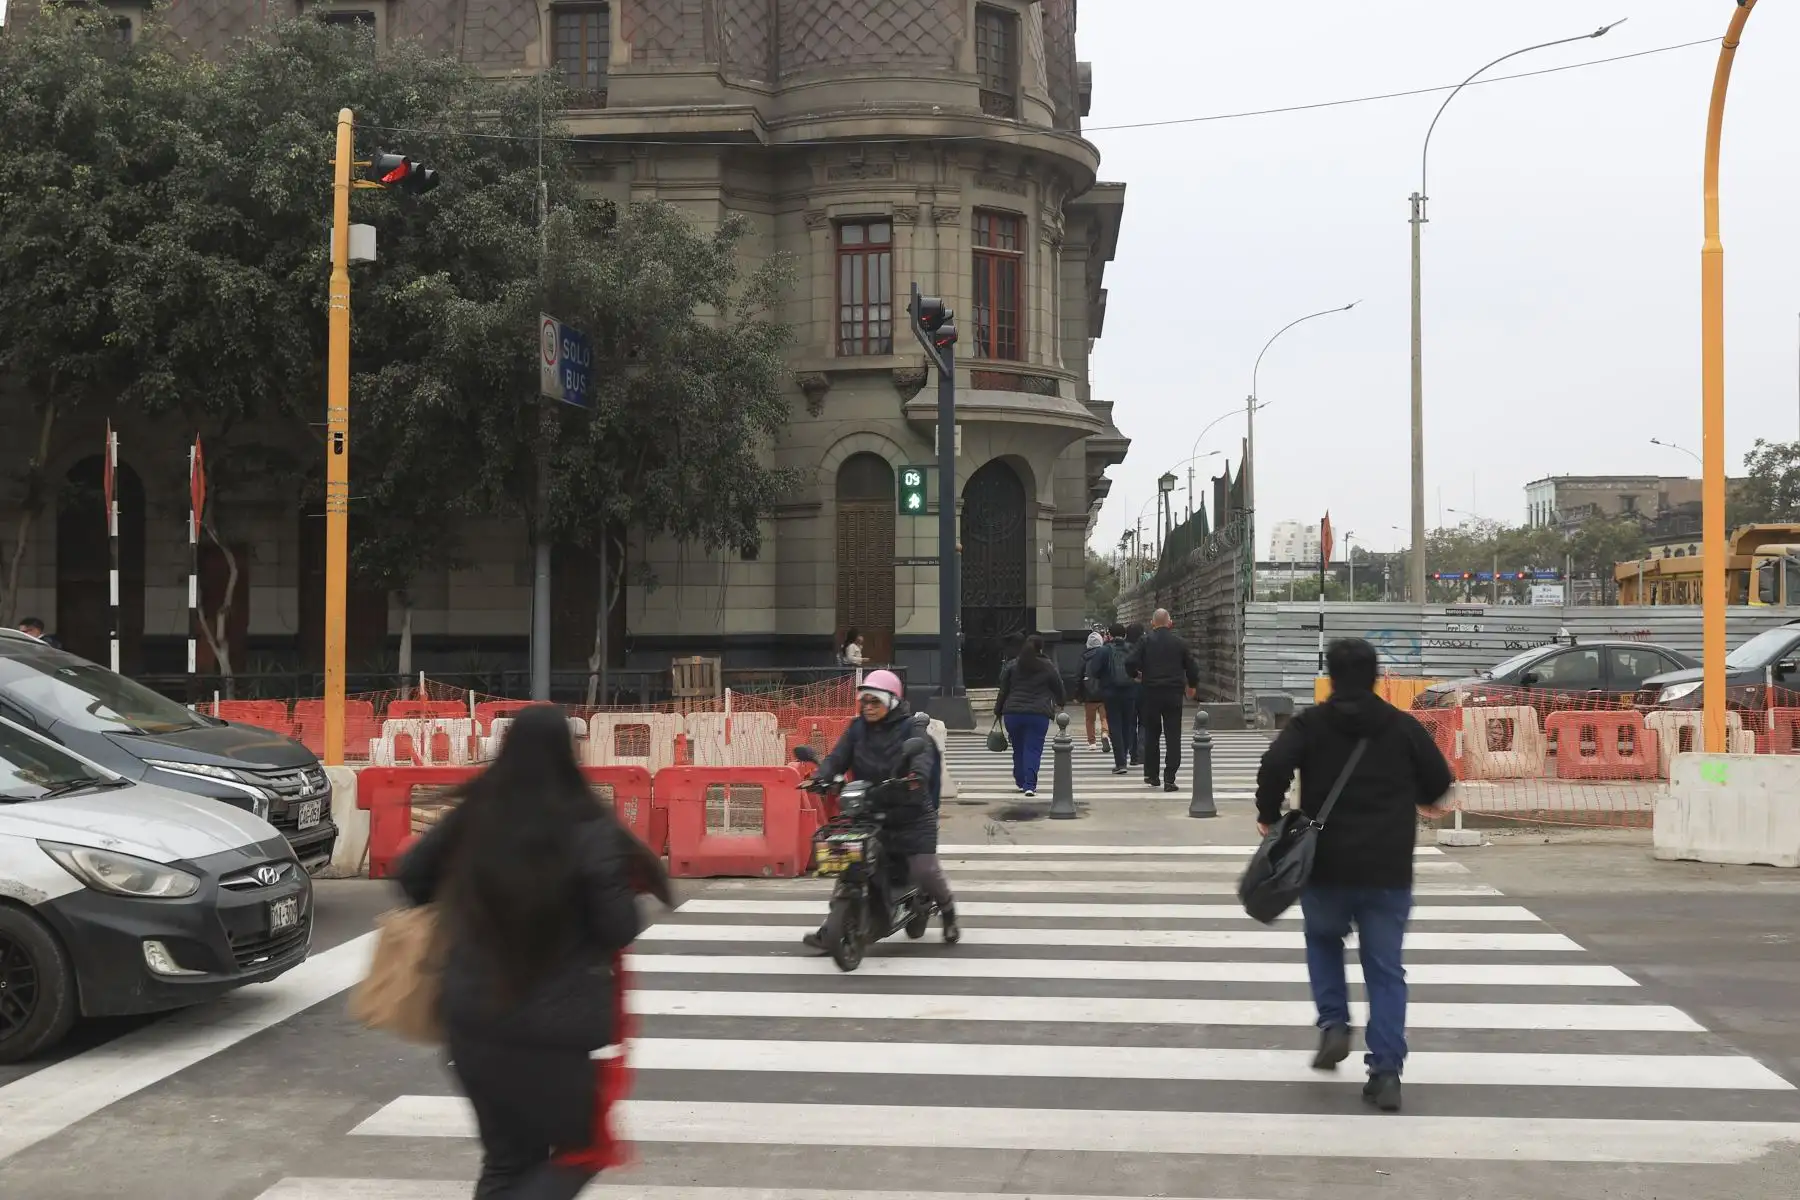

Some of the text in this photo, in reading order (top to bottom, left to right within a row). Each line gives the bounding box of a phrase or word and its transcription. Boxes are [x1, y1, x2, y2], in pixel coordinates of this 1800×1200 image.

[563, 338, 590, 367] SOLO
[566, 369, 587, 393] BUS
[905, 472, 920, 486] 09
